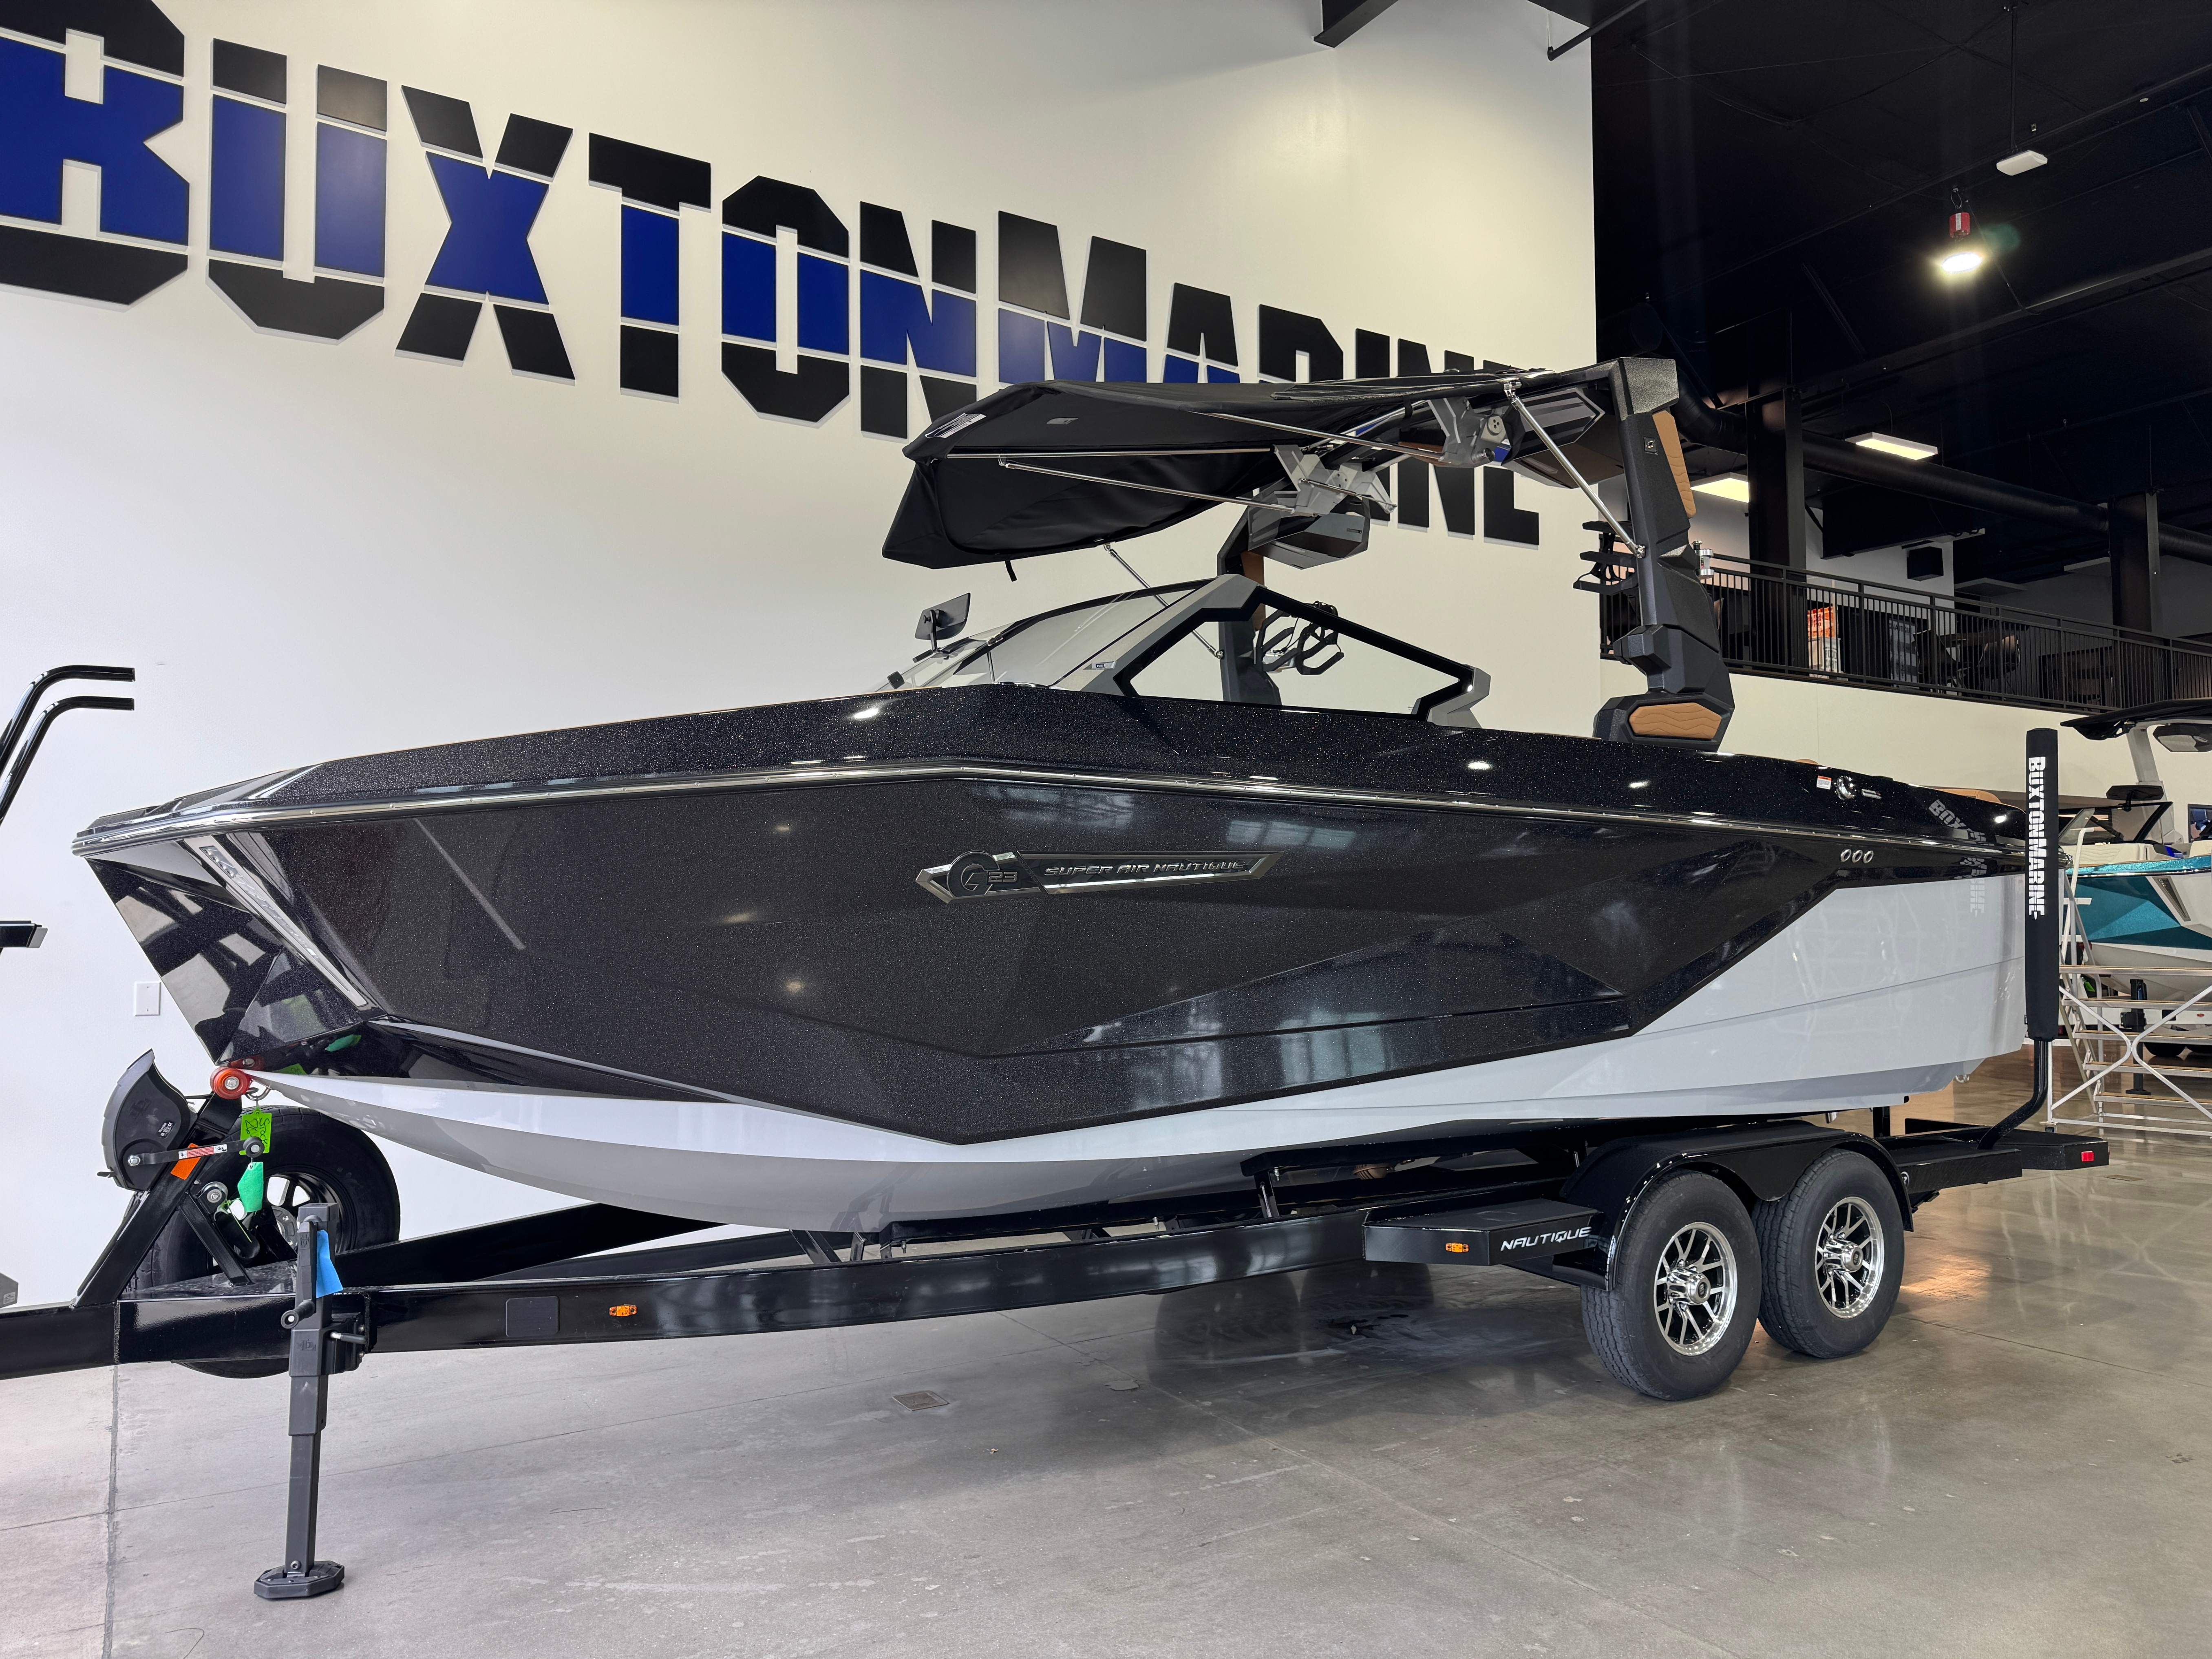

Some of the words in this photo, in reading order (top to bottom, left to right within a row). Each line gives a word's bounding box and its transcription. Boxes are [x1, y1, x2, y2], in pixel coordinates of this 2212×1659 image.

[2028, 756, 2047, 920] BUXTONMARINE
[1044, 865, 1113, 876] SUPER
[1116, 864, 1150, 874] AIR
[1153, 861, 1246, 873] NAUTIQUE
[1500, 1226, 1592, 1252] NAUTIQUE
